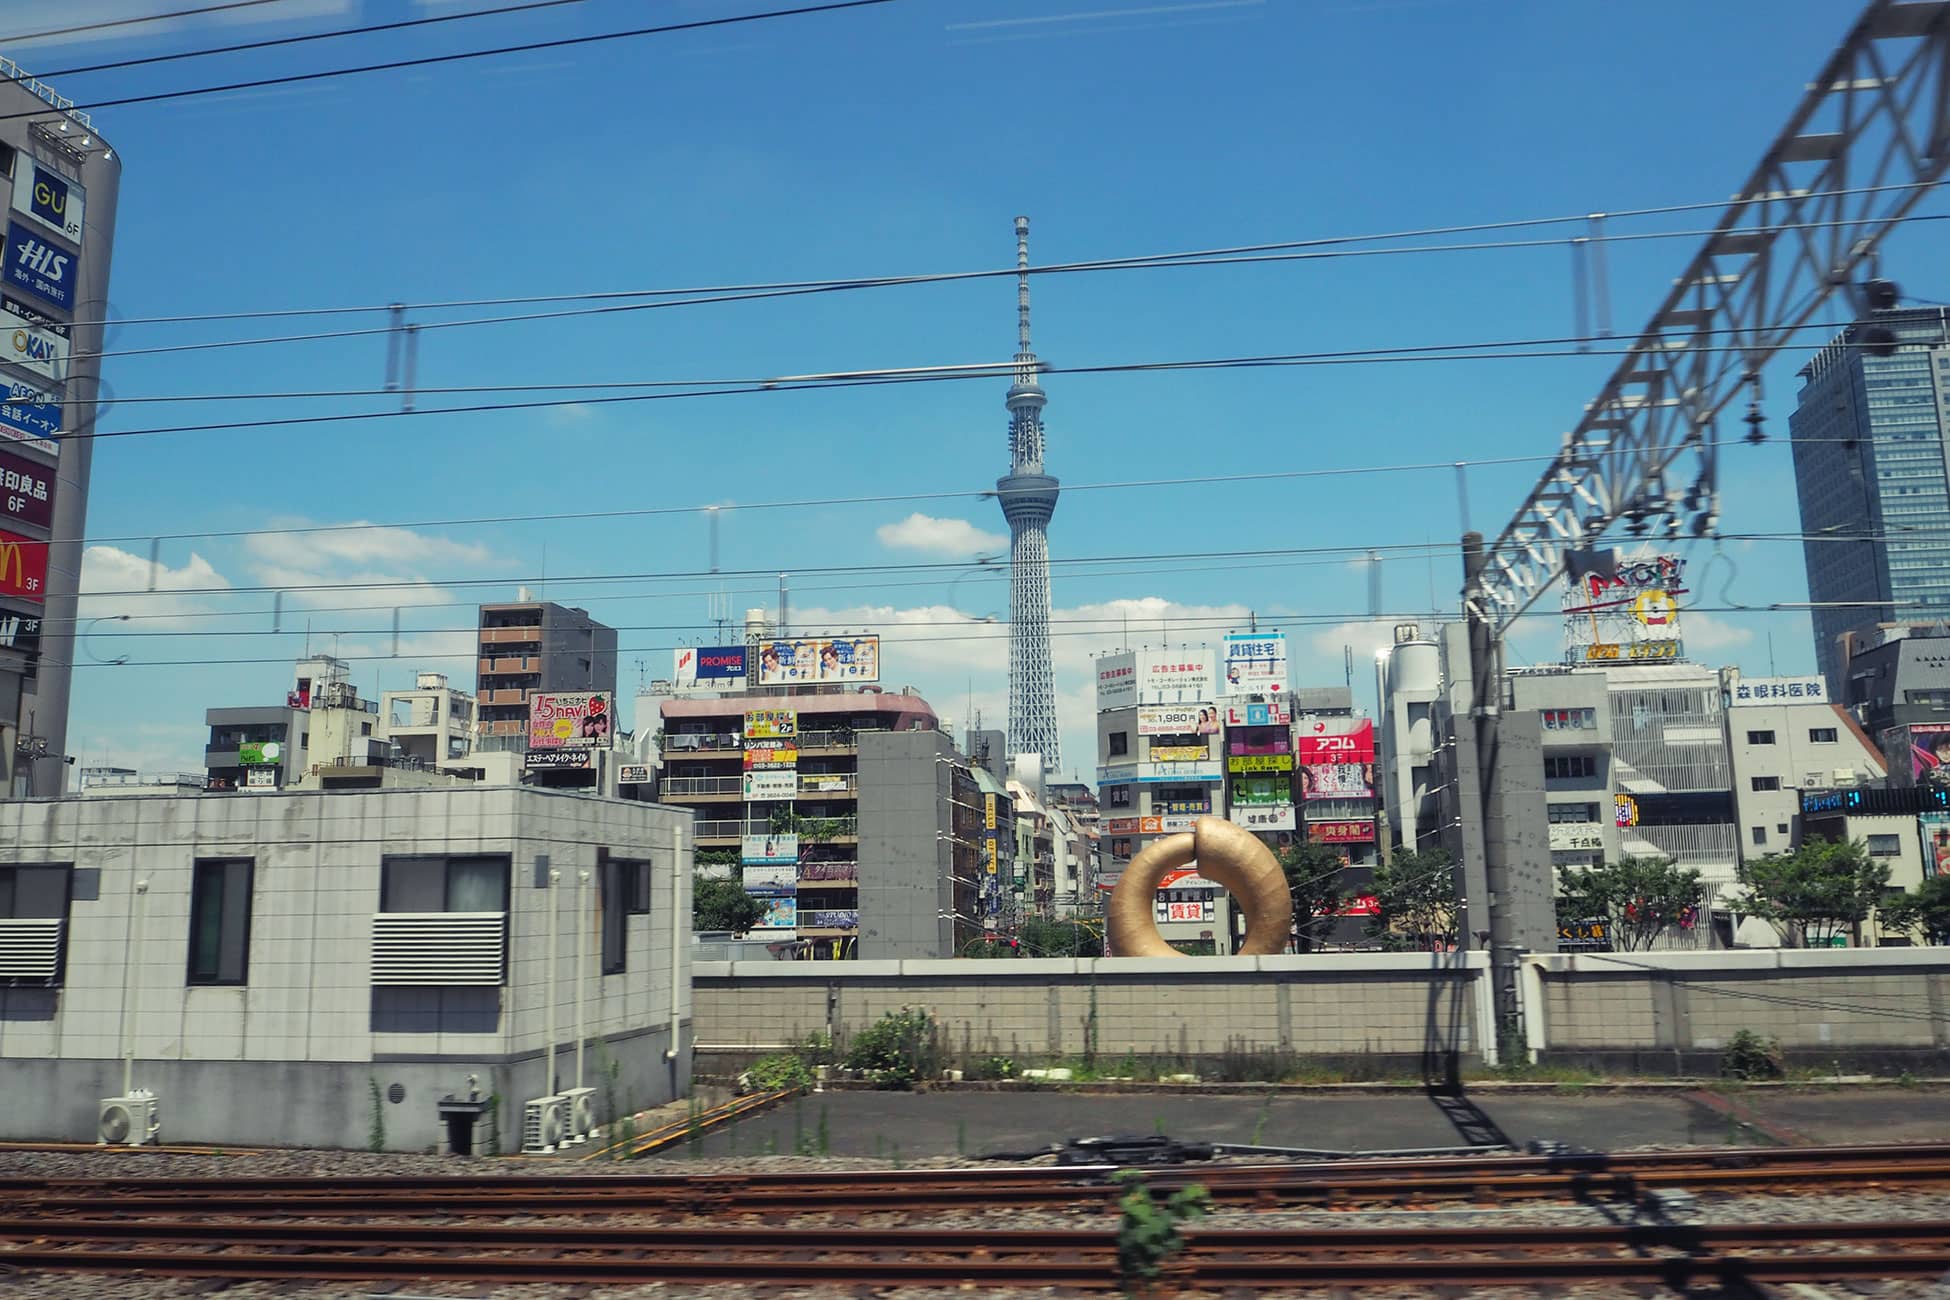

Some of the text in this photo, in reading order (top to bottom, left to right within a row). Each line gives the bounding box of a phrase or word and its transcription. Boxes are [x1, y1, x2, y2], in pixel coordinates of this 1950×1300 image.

[34, 182, 64, 215] GU
[66, 222, 79, 236] 6F
[12, 329, 55, 365] OKAY
[8, 496, 26, 513] 6F
[26, 577, 39, 591] 3F
[24, 619, 39, 632] 3F
[700, 654, 742, 665] PROMISE
[1152, 663, 1204, 674] 広告主募集中
[1736, 682, 1822, 699] 森眼科医院
[535, 695, 556, 718] 15
[780, 723, 793, 734] 2F
[1316, 738, 1355, 750] アコム
[1169, 903, 1201, 920] 賃貸
